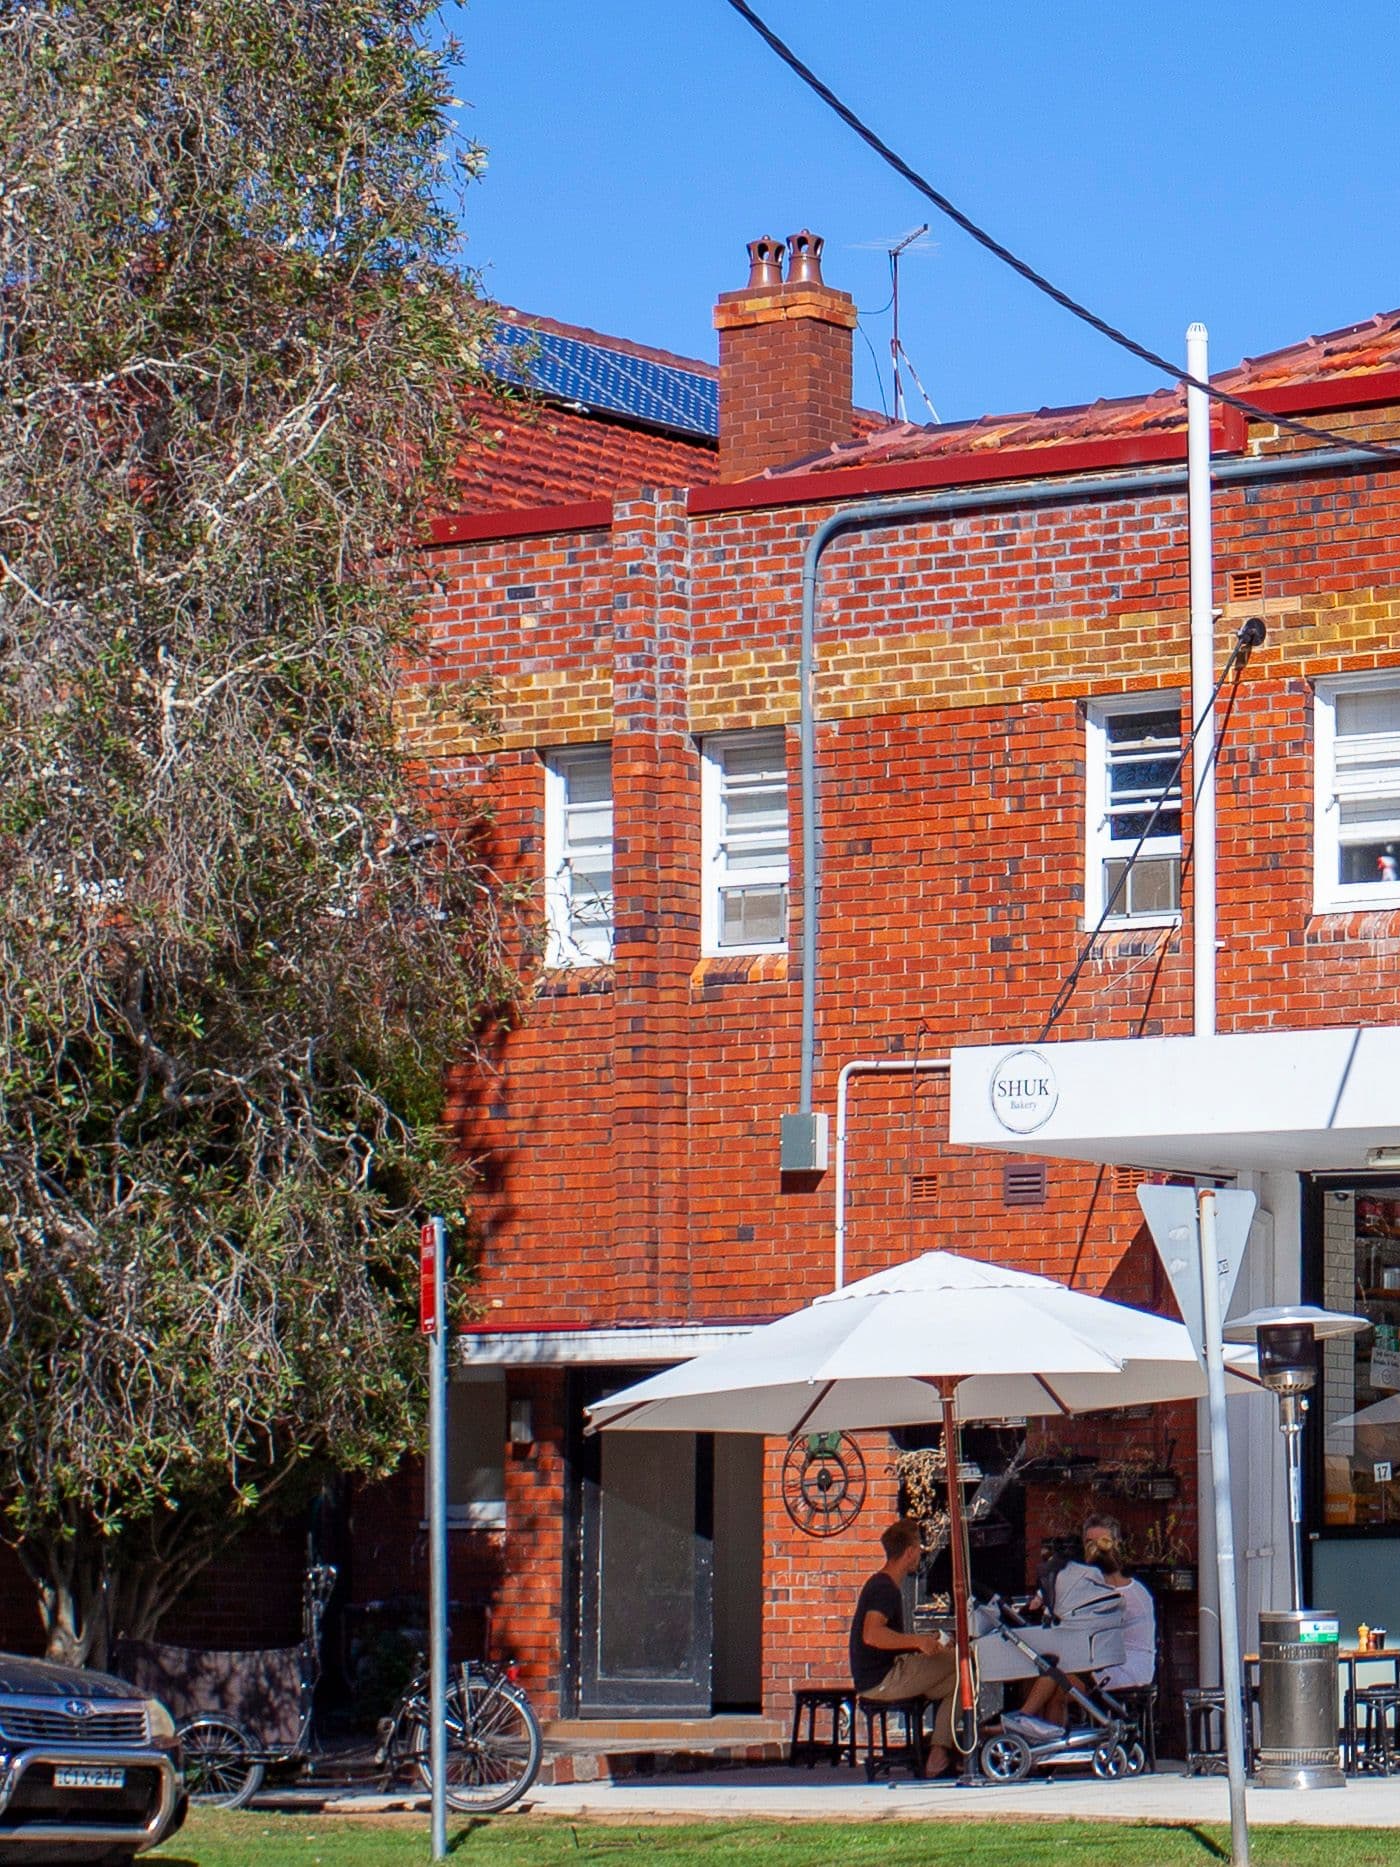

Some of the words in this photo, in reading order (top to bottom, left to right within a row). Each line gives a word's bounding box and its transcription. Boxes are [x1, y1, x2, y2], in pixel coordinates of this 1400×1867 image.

[998, 1078, 1049, 1097] SHUK
[1010, 1101, 1037, 1112] Bakery
[1376, 1465, 1389, 1480] 17
